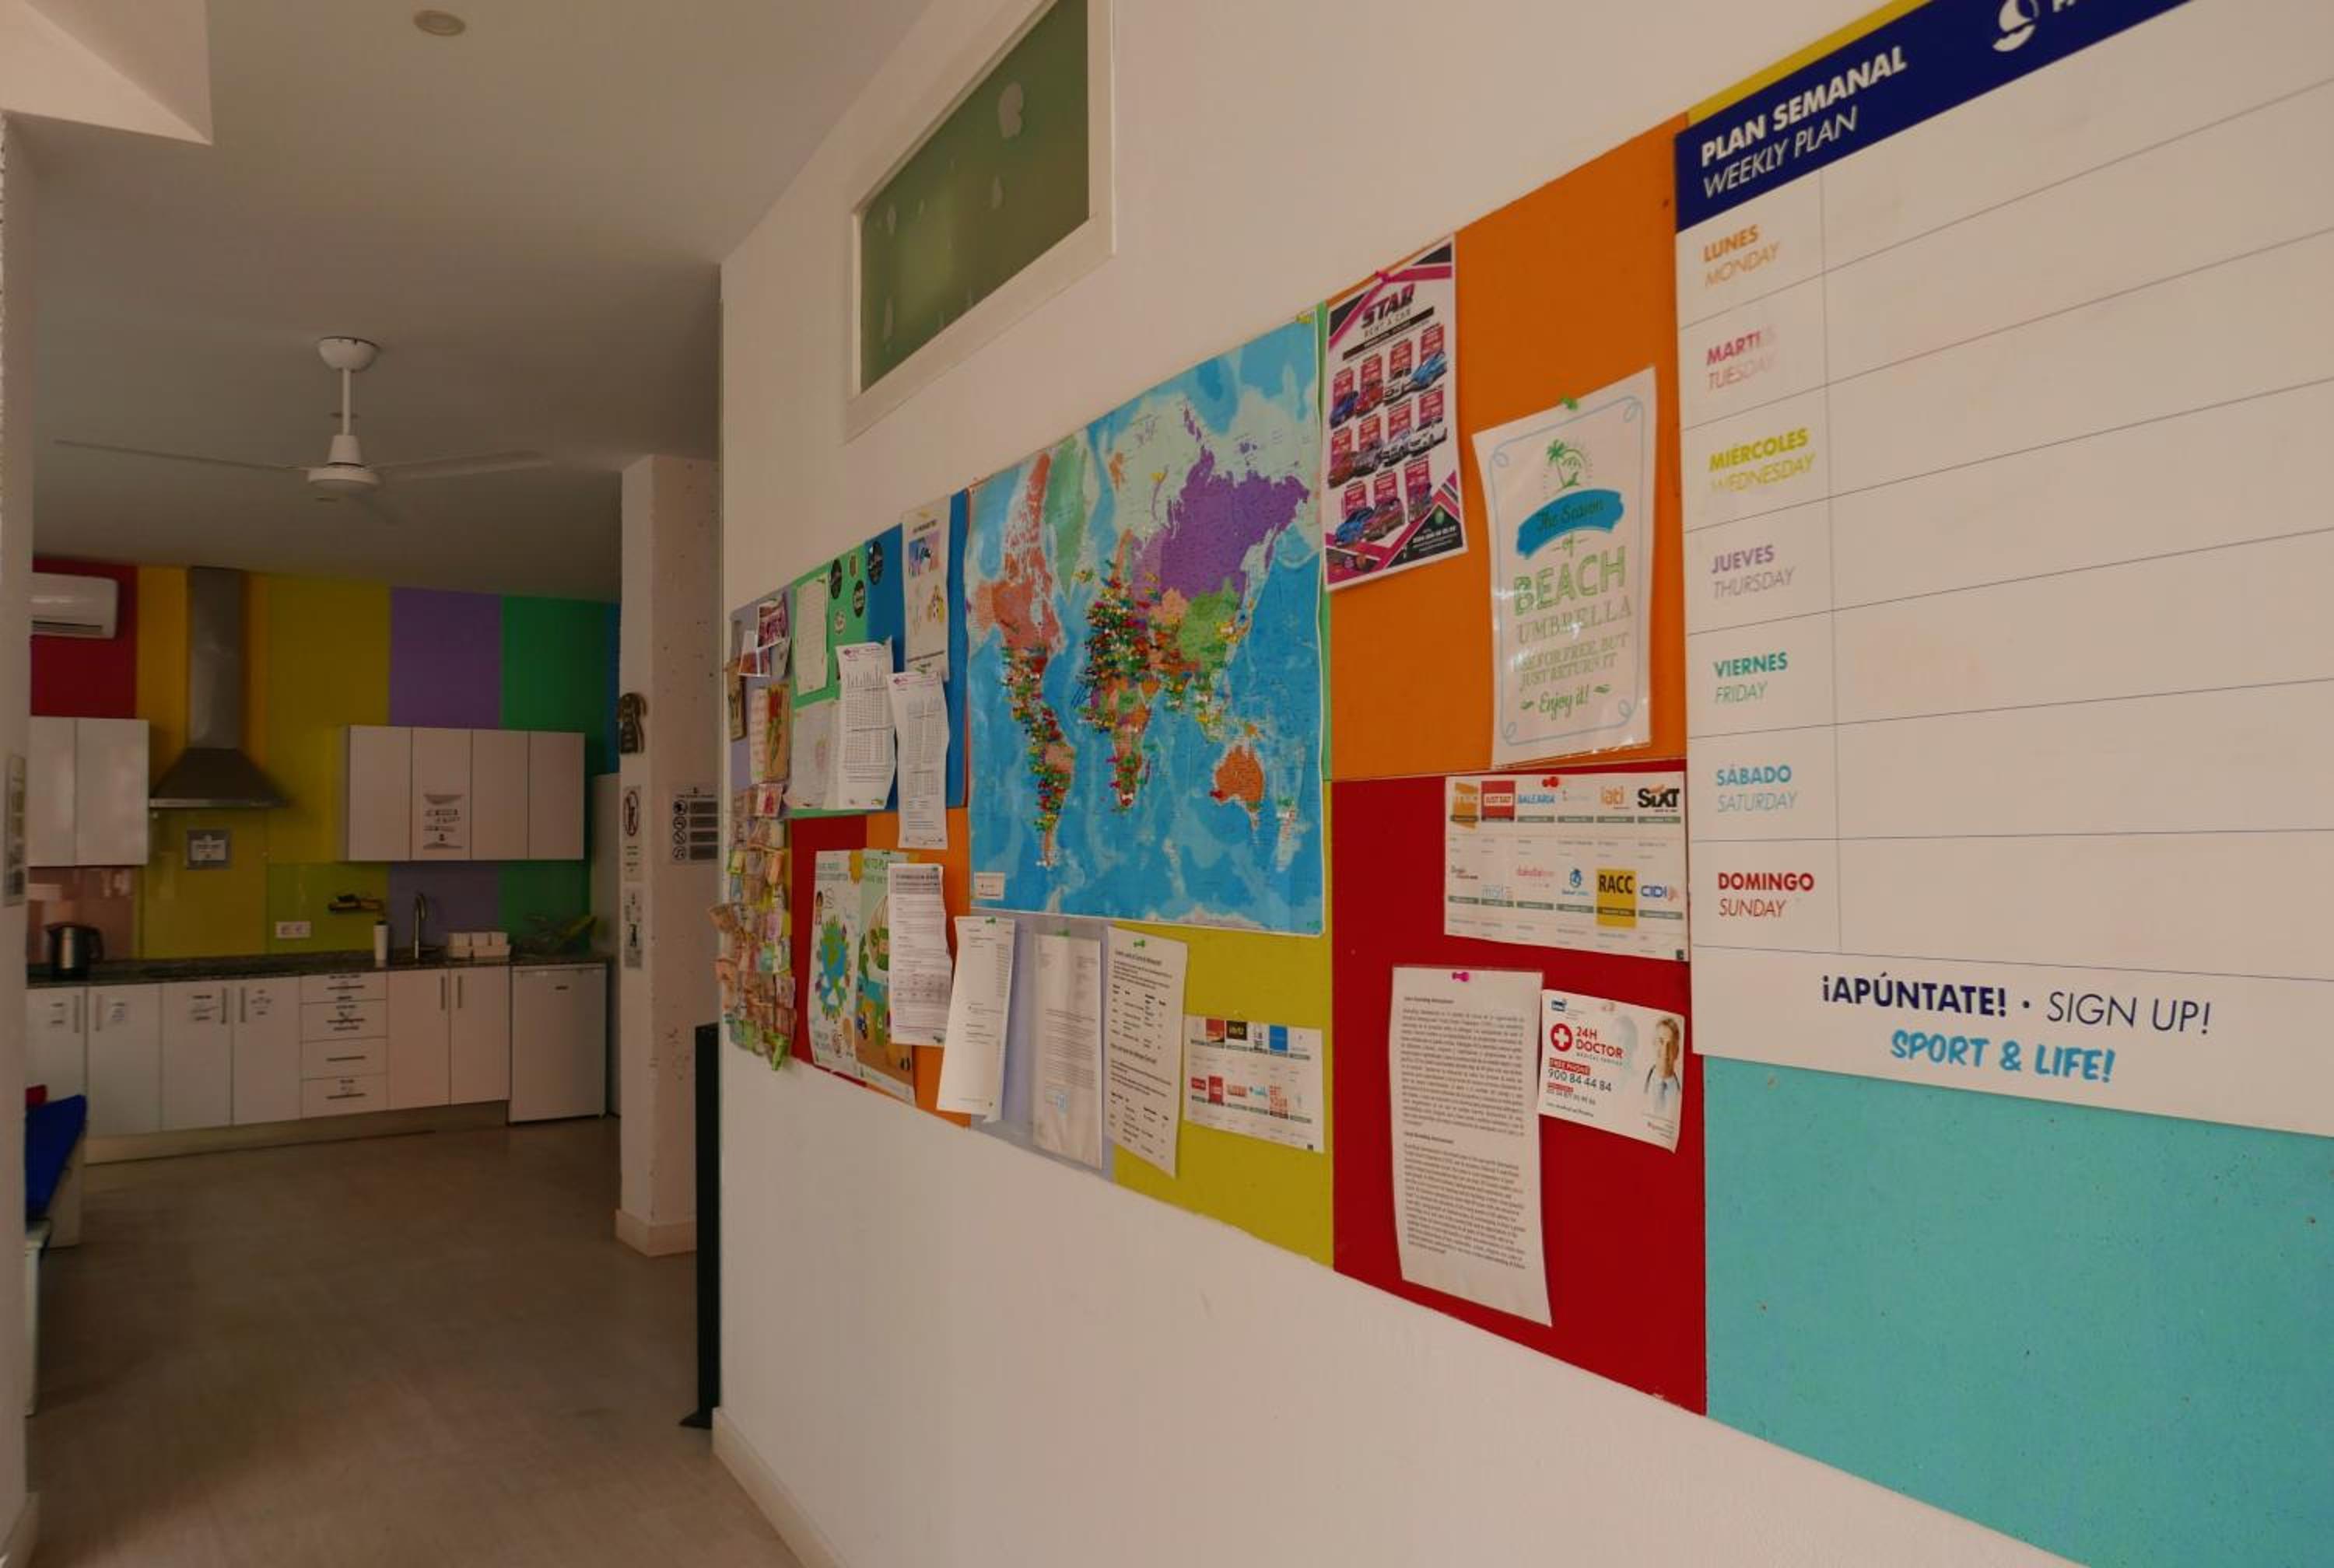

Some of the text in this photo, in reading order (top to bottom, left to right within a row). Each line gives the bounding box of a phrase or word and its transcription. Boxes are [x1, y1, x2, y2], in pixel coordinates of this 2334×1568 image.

[1701, 45, 1907, 167] PLAN SEMANAL
[1703, 105, 1857, 198] WEEKLY PLAN
[1704, 224, 1758, 262] LUNES
[1705, 240, 1780, 287] MONDAY
[1712, 545, 1774, 574] JUEVES
[1514, 546, 1625, 615] BEACH
[1714, 567, 1795, 598] THURSDAY
[1519, 595, 1631, 644] UMBRELLA
[1713, 652, 1788, 677] VIERNES
[1715, 681, 1768, 703] FRIDAY
[1717, 791, 1798, 813] SATURDAY
[1599, 874, 1633, 894] RACC
[1718, 873, 1814, 891] DOMINGO
[1719, 898, 1786, 917] SUNDAY
[1822, 972, 2211, 1034] ¡APÚNTATE! SIGN UP!
[1575, 1027, 1597, 1040] 24H
[1576, 1038, 1624, 1059] DOCTOR
[1890, 1029, 2115, 1083] SPORT & LIFE!
[1548, 1069, 1568, 1081] 900
